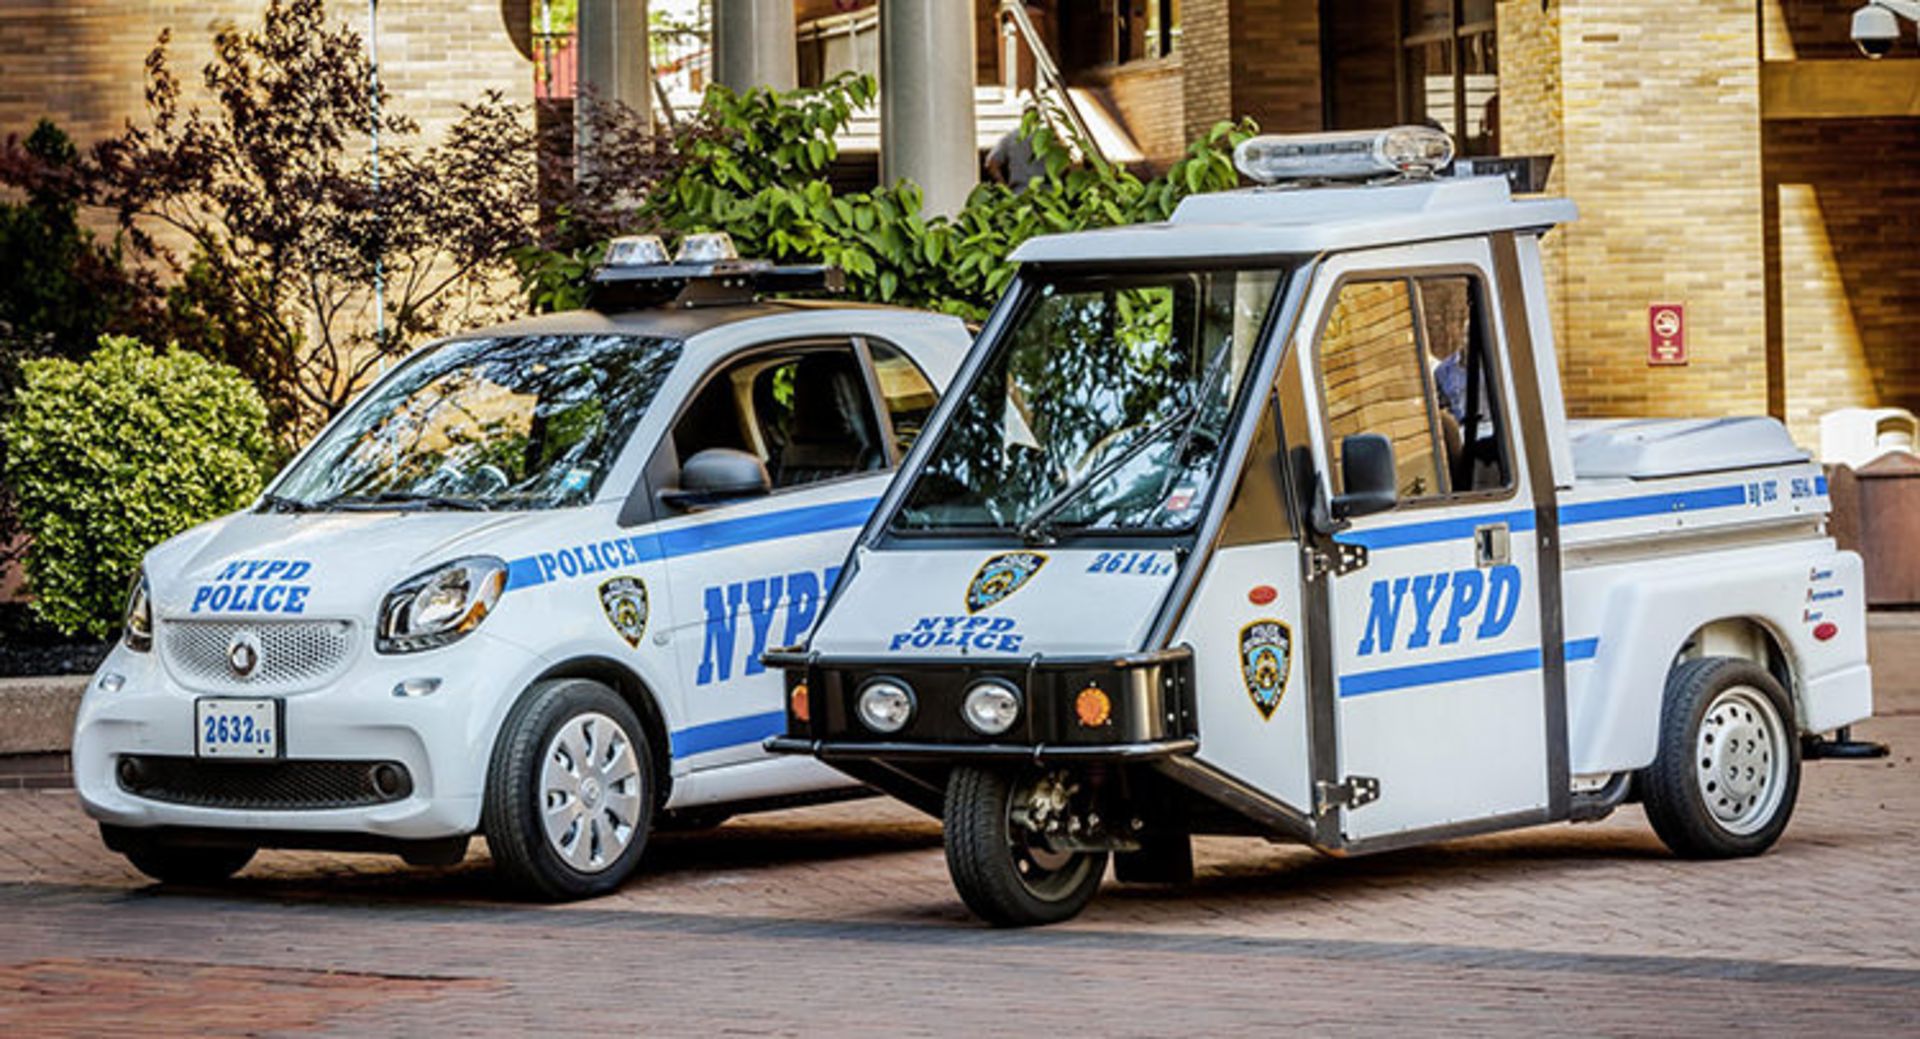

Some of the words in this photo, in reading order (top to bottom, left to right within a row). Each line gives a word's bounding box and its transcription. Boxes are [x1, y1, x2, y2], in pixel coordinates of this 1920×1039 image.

[216, 559, 312, 581] NYPD
[540, 538, 637, 582] POLICE
[190, 584, 311, 614] POLICE
[1356, 564, 1522, 656] NYPD
[912, 616, 1016, 633] NYPD
[888, 632, 1024, 653] POLICE
